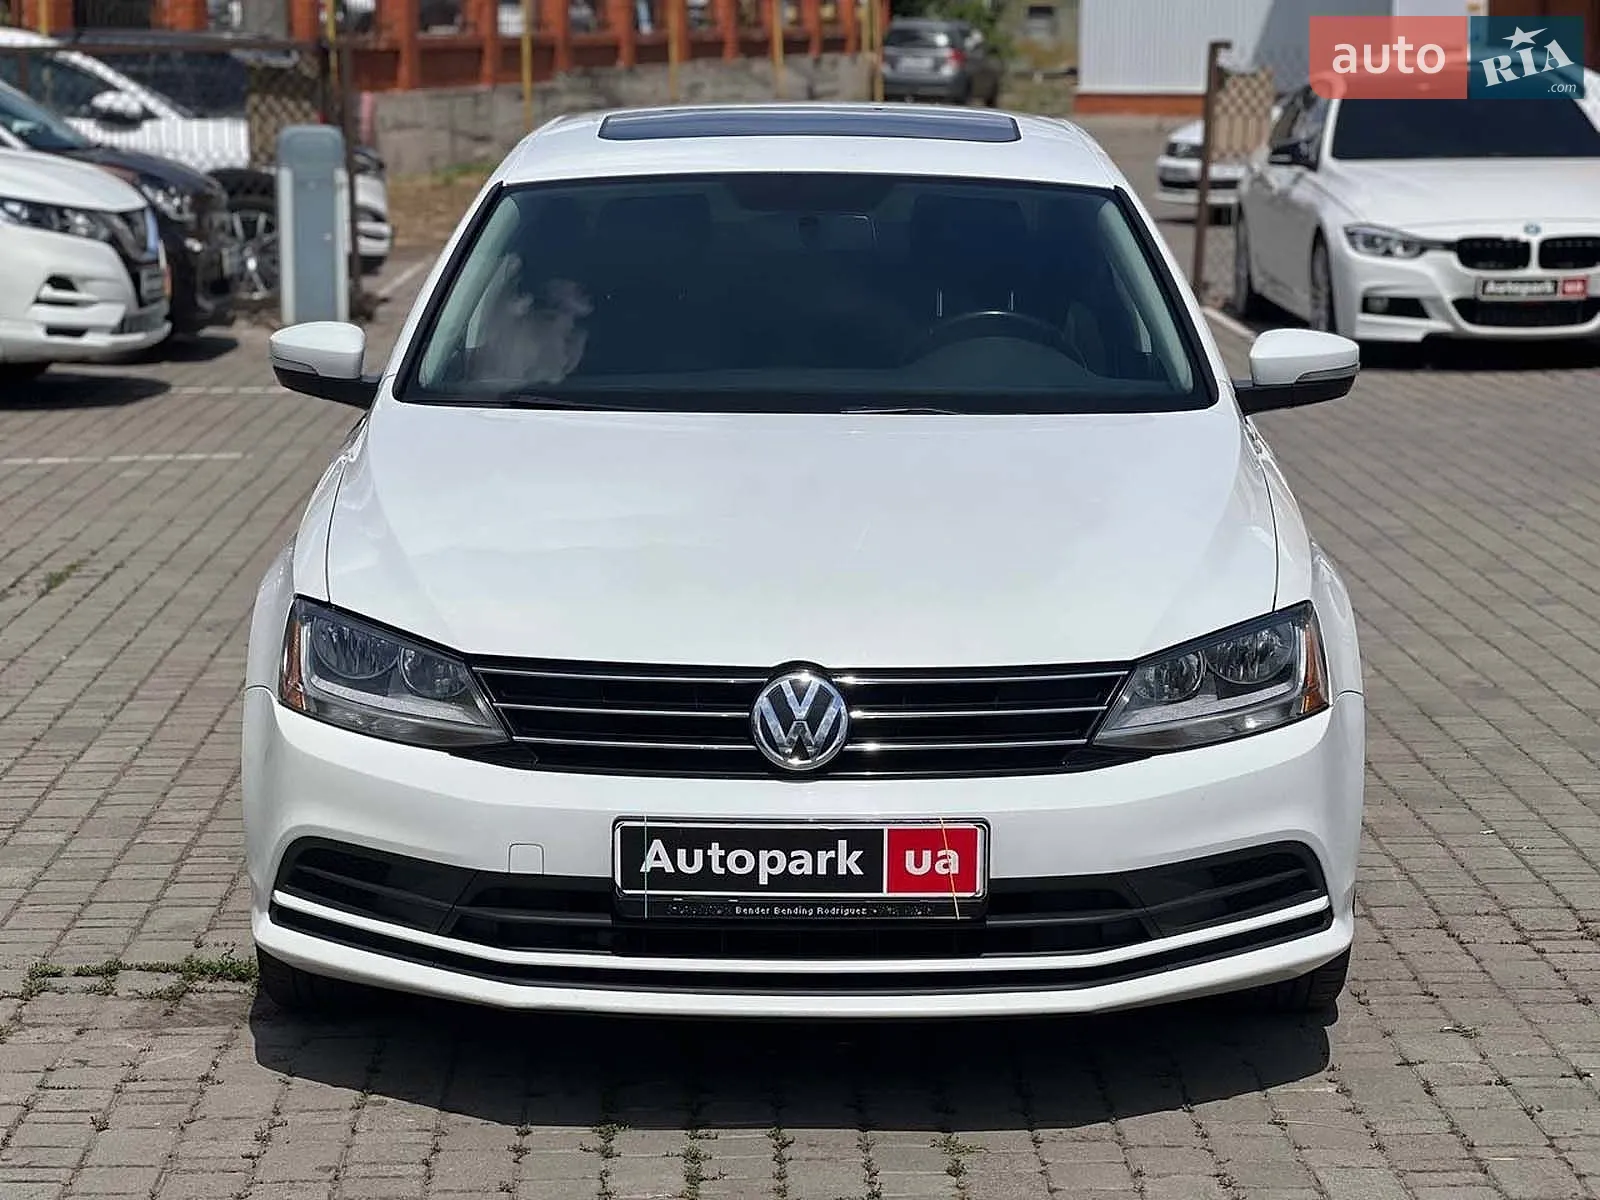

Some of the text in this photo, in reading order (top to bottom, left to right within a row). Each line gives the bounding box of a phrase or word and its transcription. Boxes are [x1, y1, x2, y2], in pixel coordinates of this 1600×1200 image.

[640, 839, 960, 885] Autopark ua
[735, 905, 770, 915] Bender
[773, 905, 814, 916] Bending
[816, 905, 867, 916] Rodriguez
